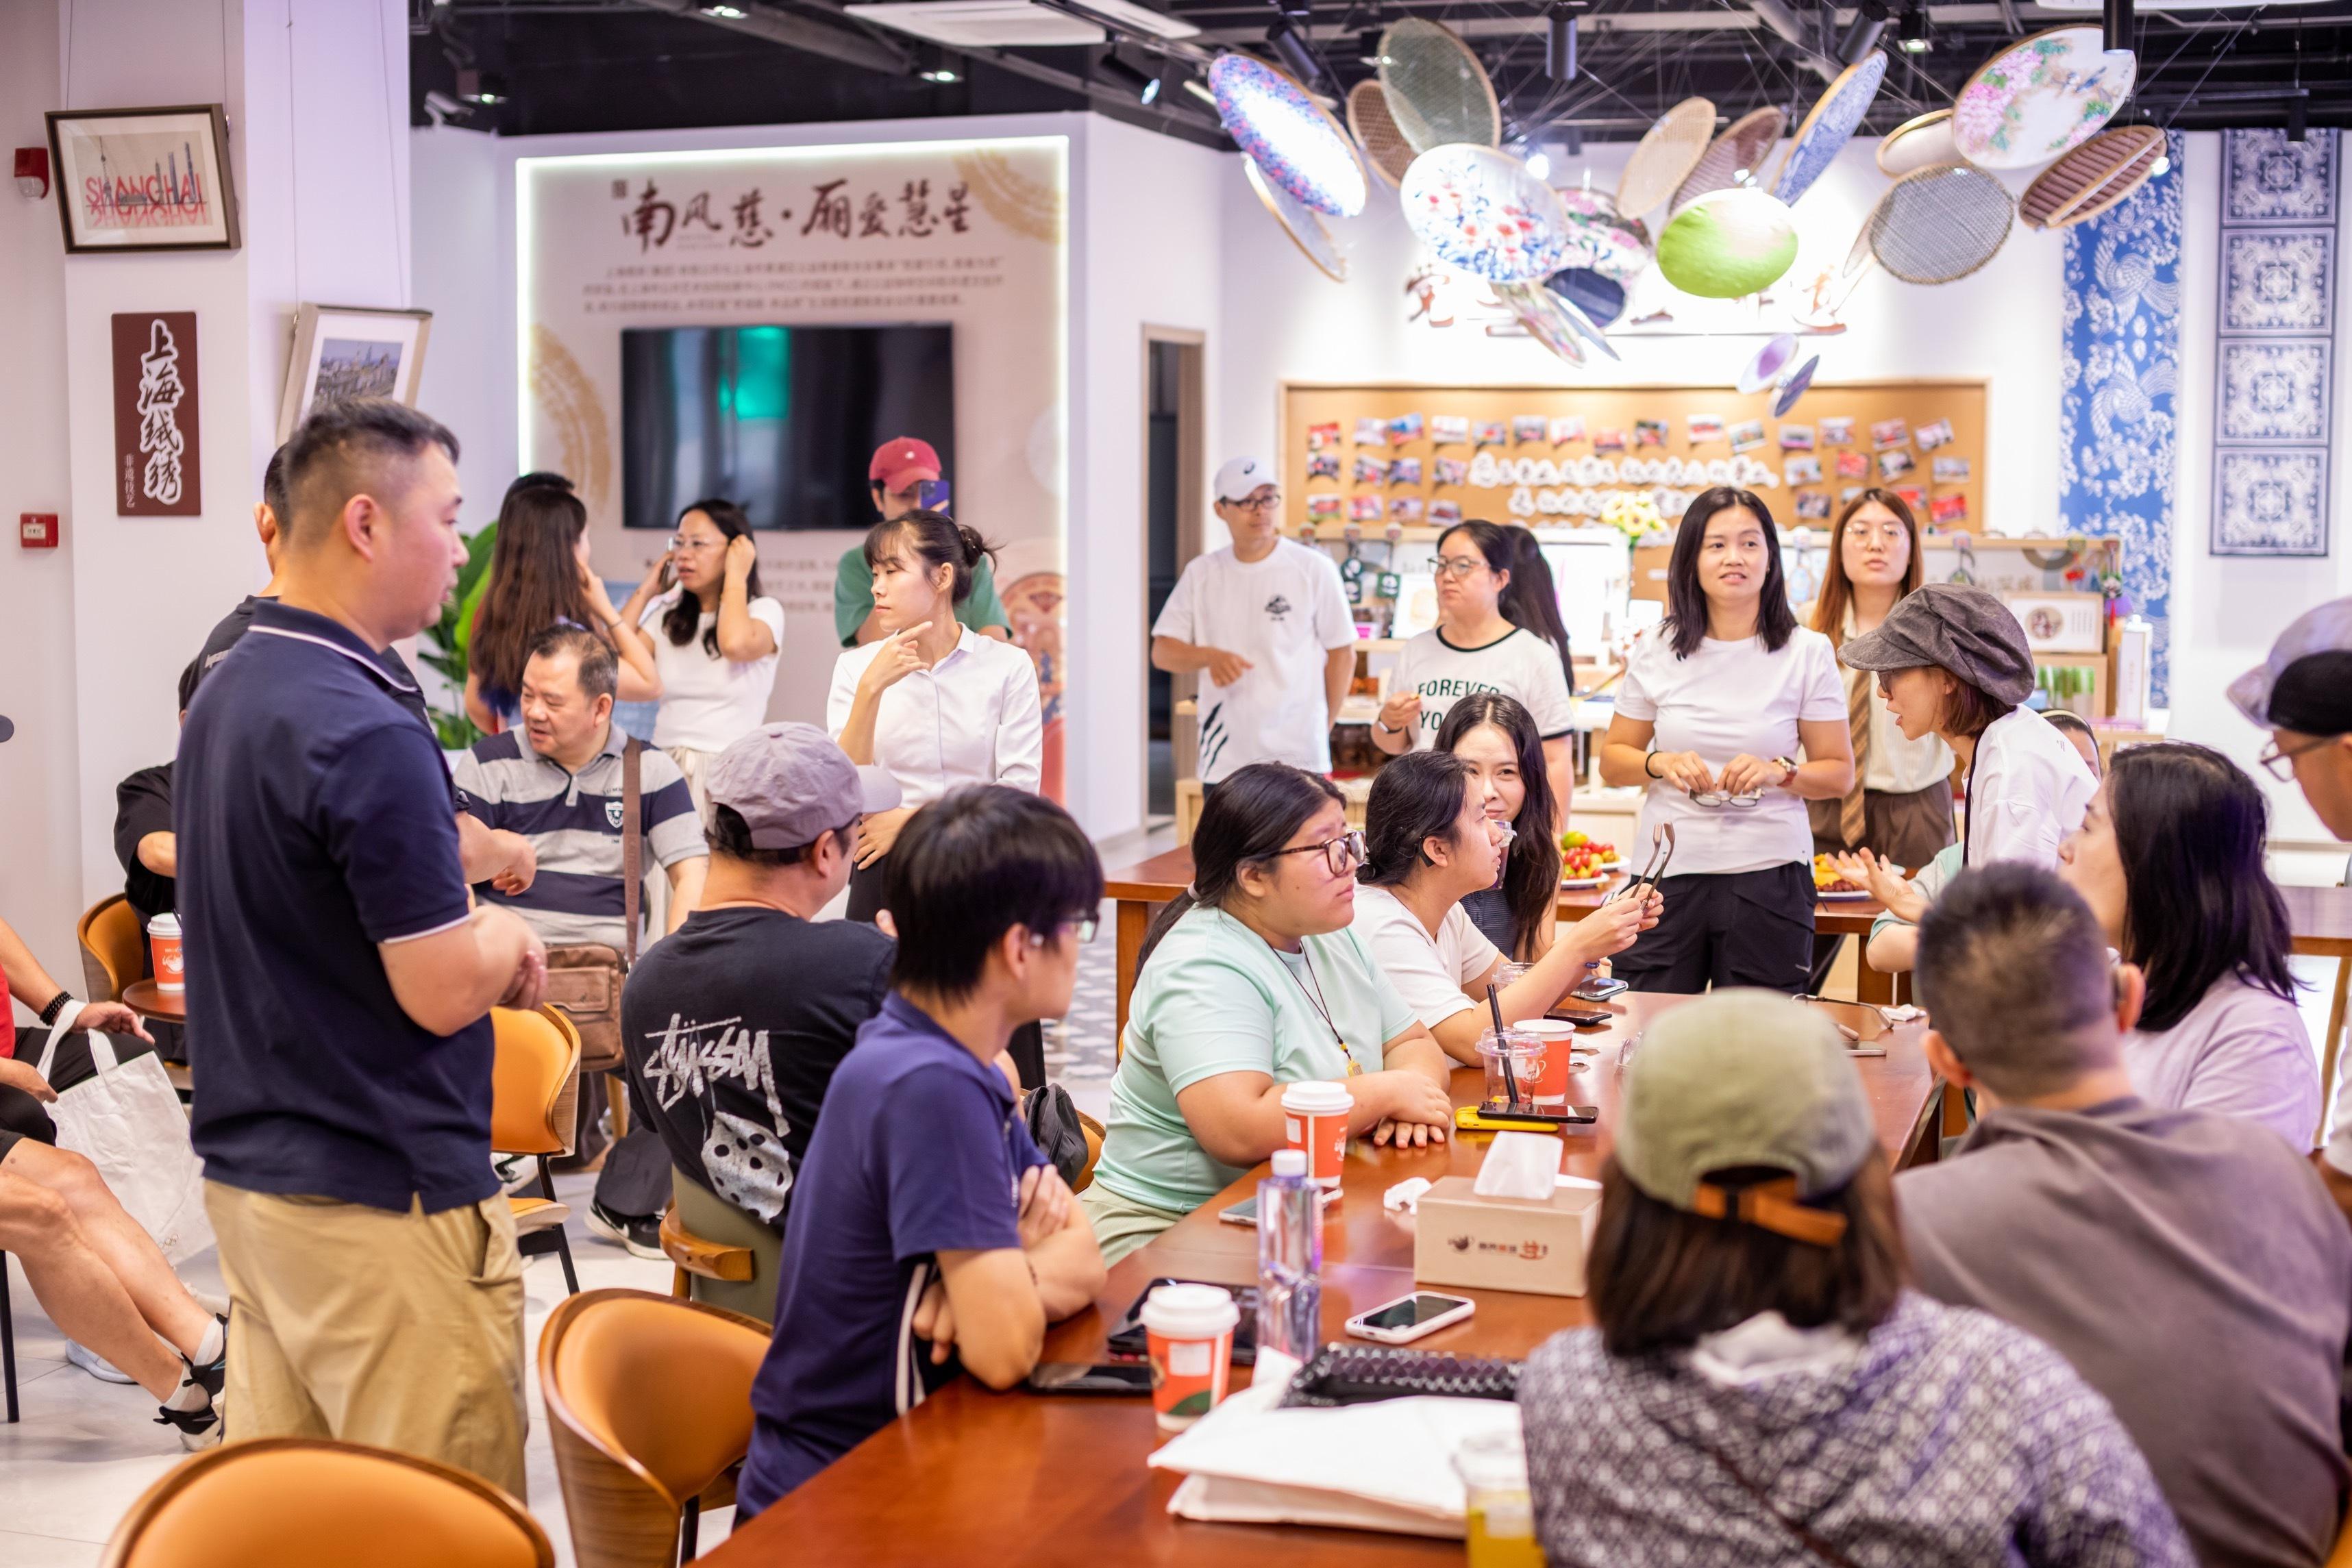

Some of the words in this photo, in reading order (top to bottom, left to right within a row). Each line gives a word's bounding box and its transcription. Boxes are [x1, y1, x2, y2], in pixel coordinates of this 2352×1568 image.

[86, 173, 204, 208] SHANGHAI
[139, 321, 183, 503] 上海绒绣
[1420, 710, 1443, 730] YO
